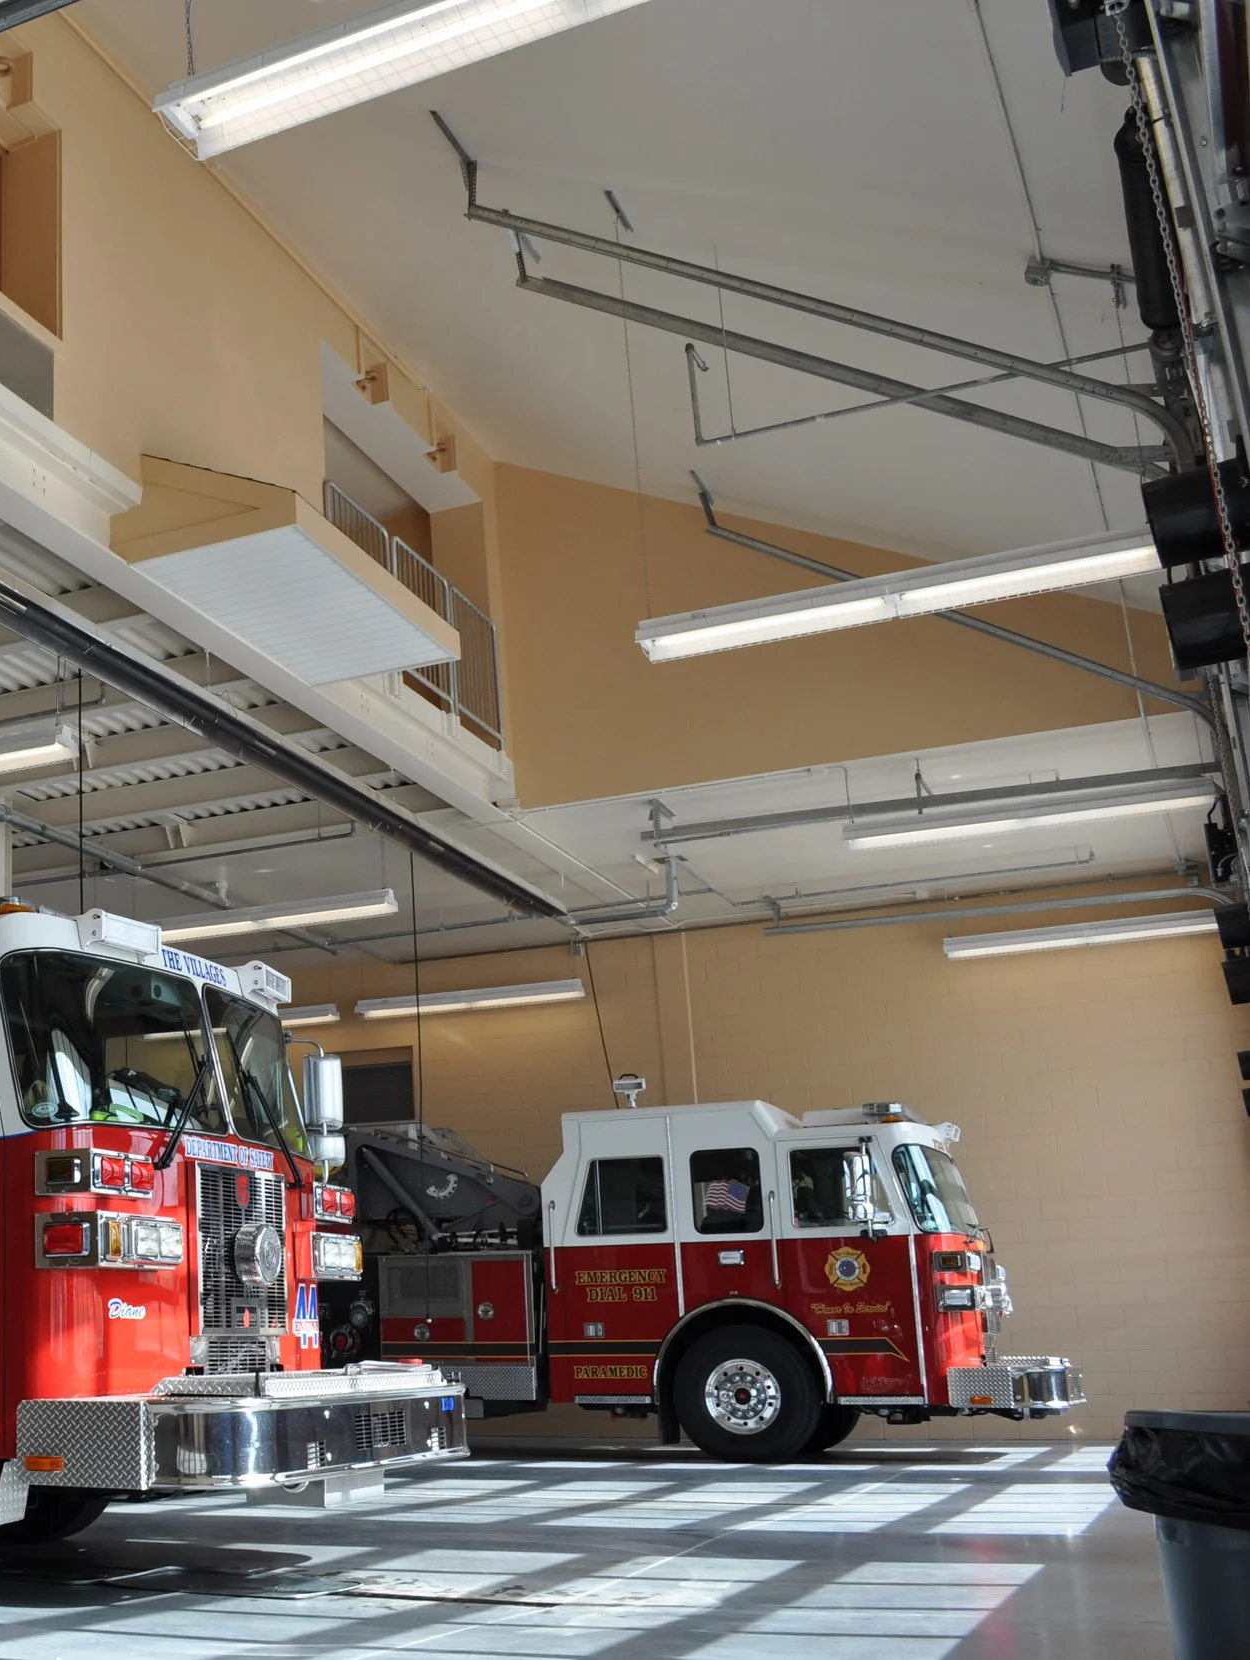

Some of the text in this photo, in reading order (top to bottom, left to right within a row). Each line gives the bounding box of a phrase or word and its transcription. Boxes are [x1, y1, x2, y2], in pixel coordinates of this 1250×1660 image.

[161, 948, 227, 987] THE VILLAGES
[184, 1137, 274, 1171] DEPARTMENT OF SAFETY
[575, 1269, 667, 1285] EMERGENCY
[587, 1286, 658, 1303] DIAL 911
[108, 1298, 146, 1320] Diane
[573, 1365, 649, 1380] PARAMEDIC
